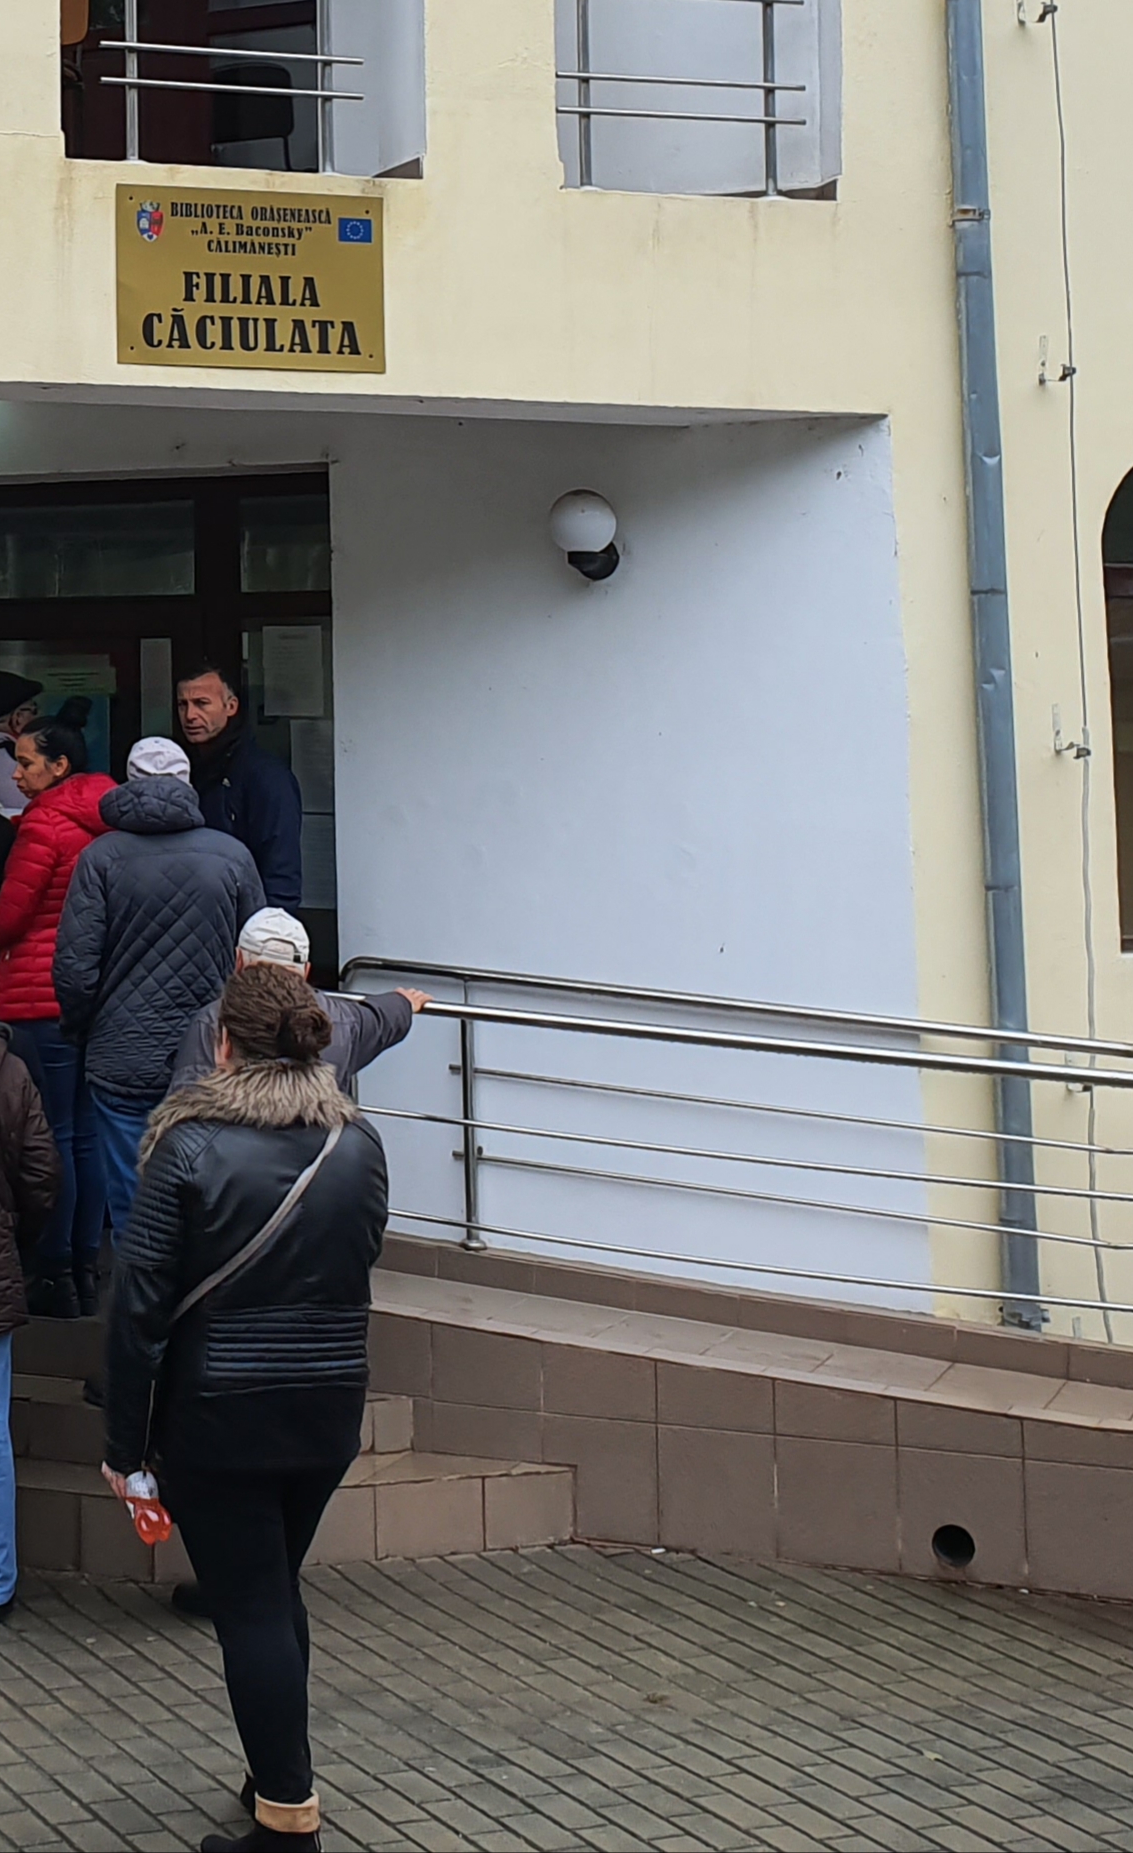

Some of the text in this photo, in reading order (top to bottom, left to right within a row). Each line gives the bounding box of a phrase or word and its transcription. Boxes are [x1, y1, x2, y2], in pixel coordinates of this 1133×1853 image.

[170, 201, 244, 221] BIBLIOTECA
[218, 223, 230, 236] E.
[182, 271, 321, 307] FILIALA
[142, 307, 362, 356] CĂCIULATA
